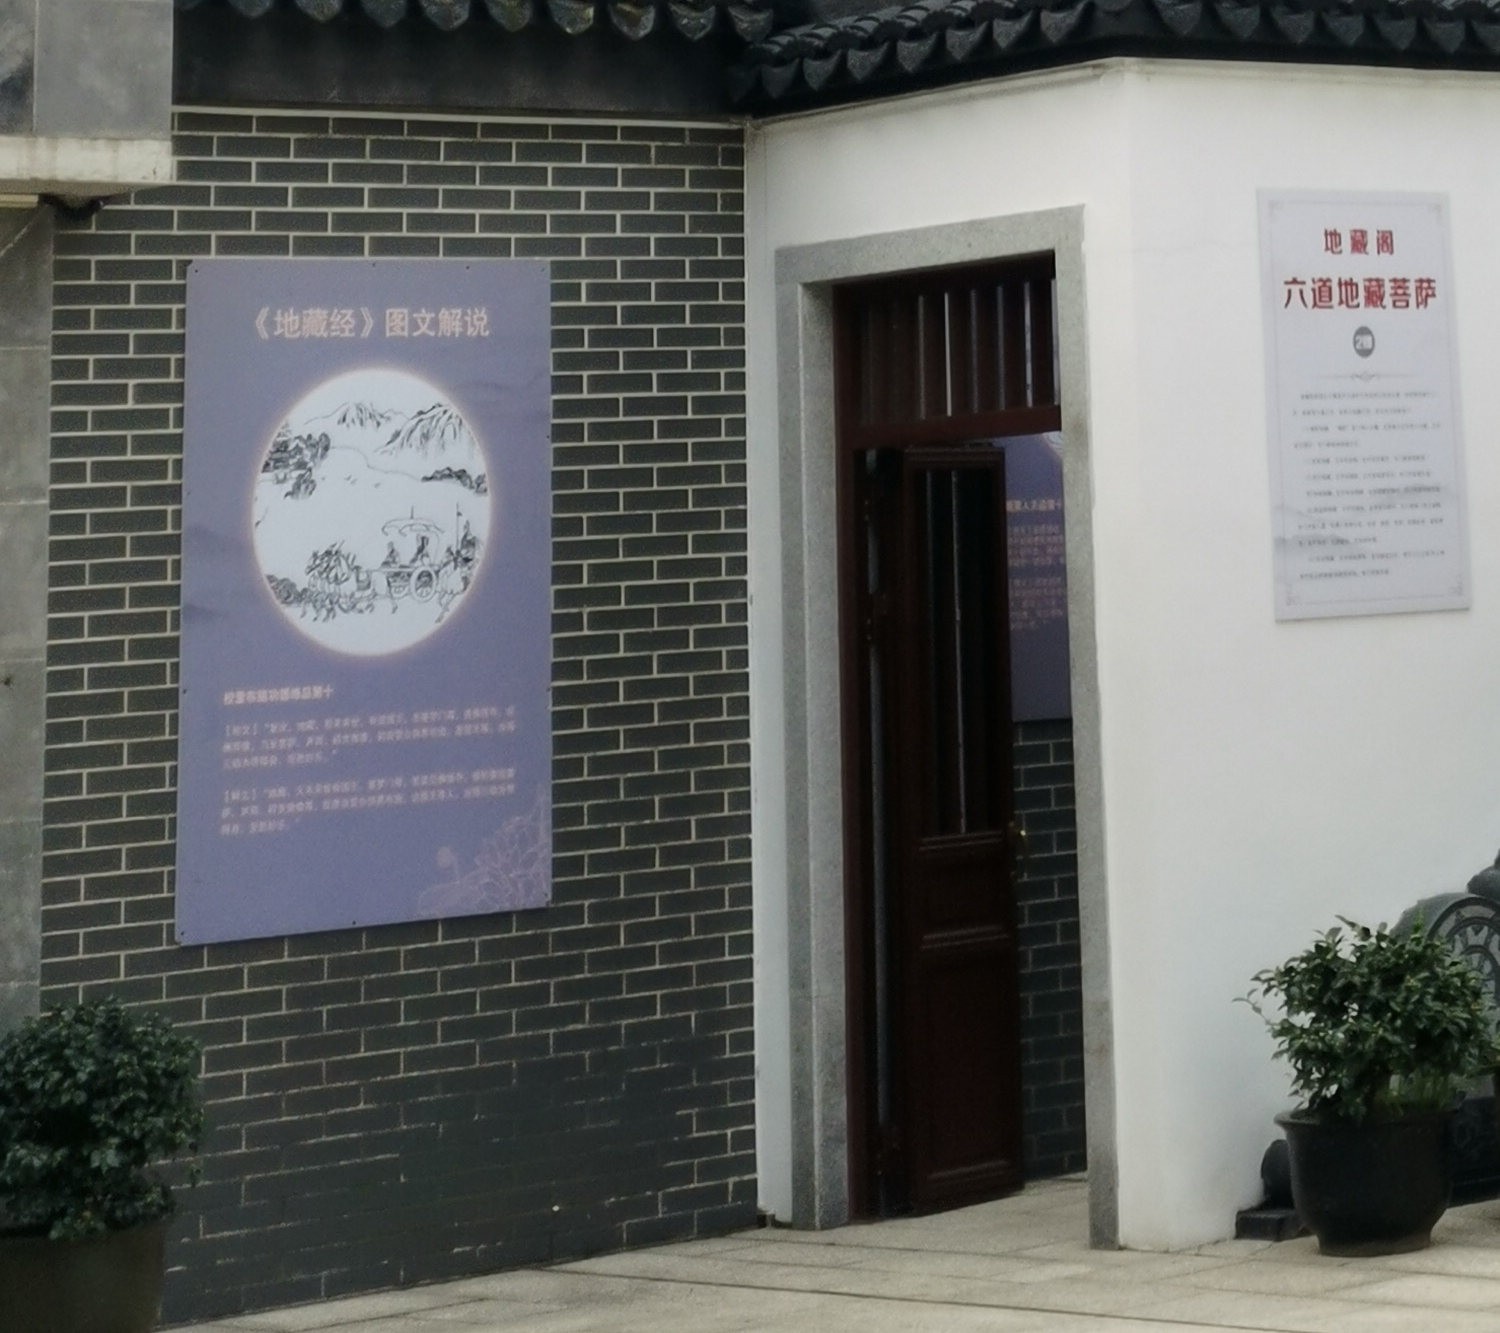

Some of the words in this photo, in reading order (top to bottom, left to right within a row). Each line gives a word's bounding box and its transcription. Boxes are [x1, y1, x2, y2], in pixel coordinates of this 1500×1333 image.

[1322, 228, 1395, 255] 地藏阁
[1283, 276, 1438, 310] 六道地藏菩萨
[252, 307, 490, 340] 《地藏经》图文解说
